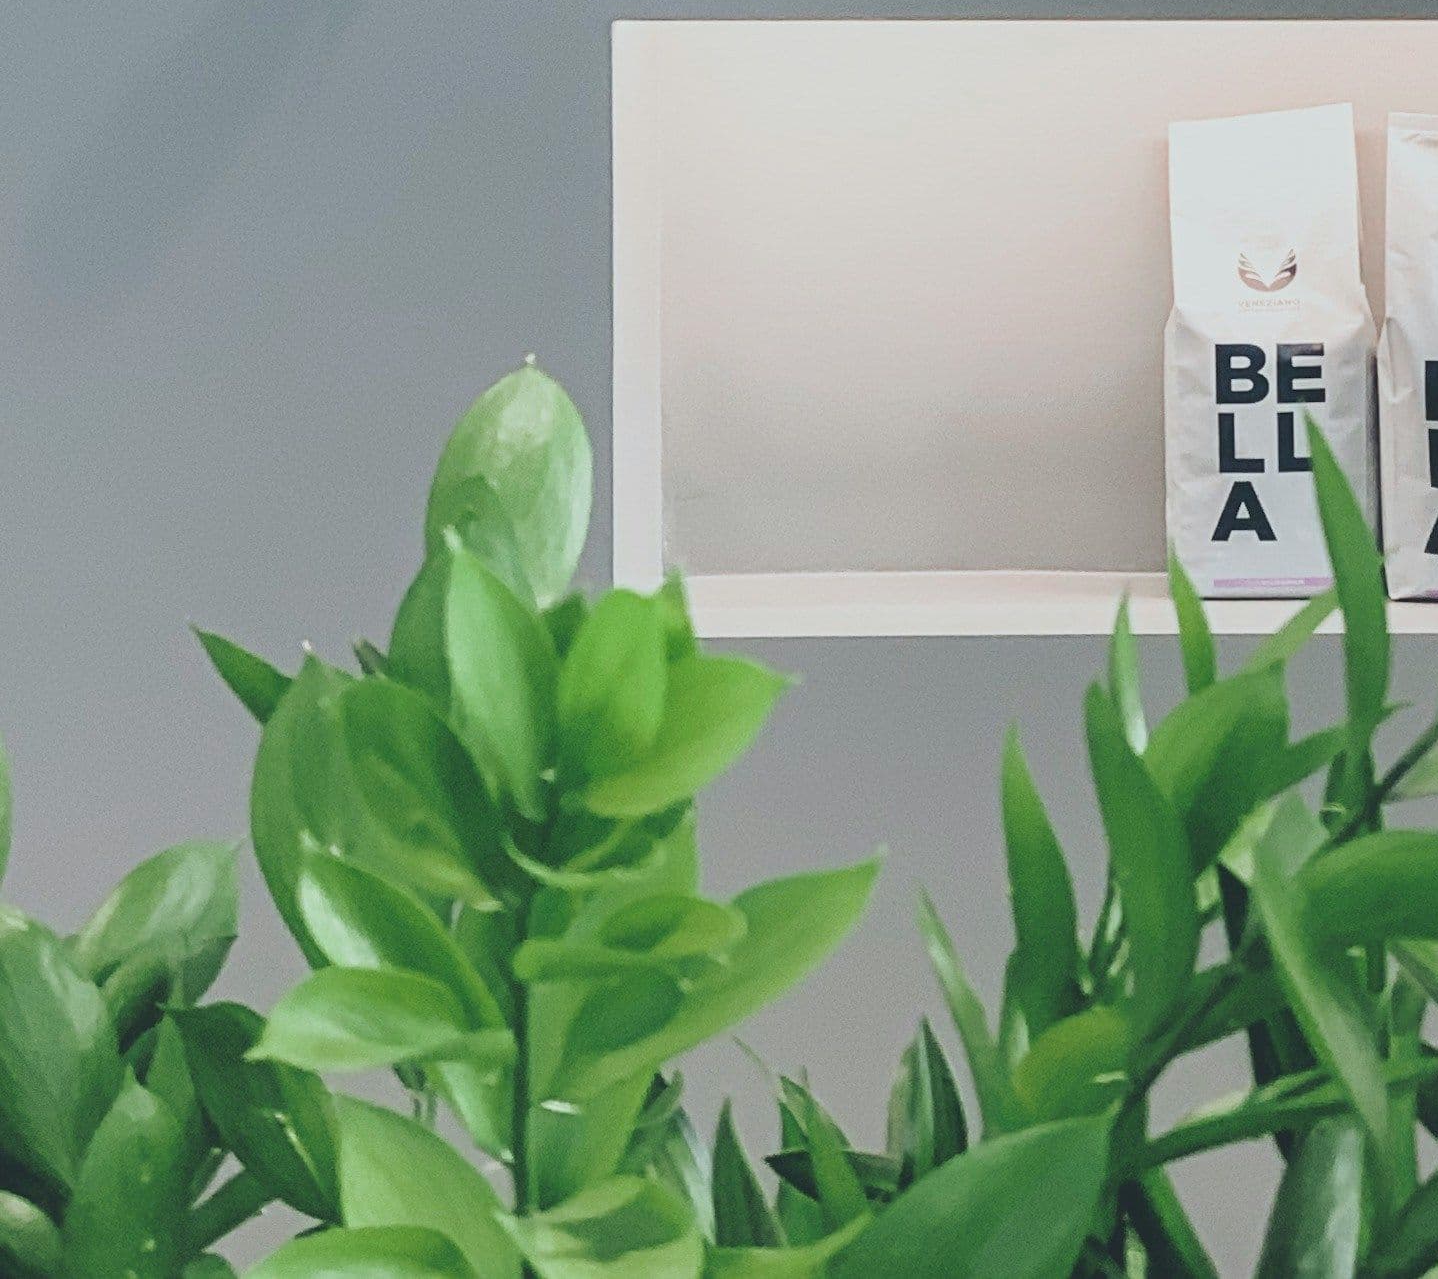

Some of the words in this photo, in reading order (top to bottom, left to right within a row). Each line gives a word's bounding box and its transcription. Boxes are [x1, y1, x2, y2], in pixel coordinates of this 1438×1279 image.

[1215, 343, 1326, 404] BE
[1218, 411, 1313, 473] LL
[1211, 481, 1277, 542] A
